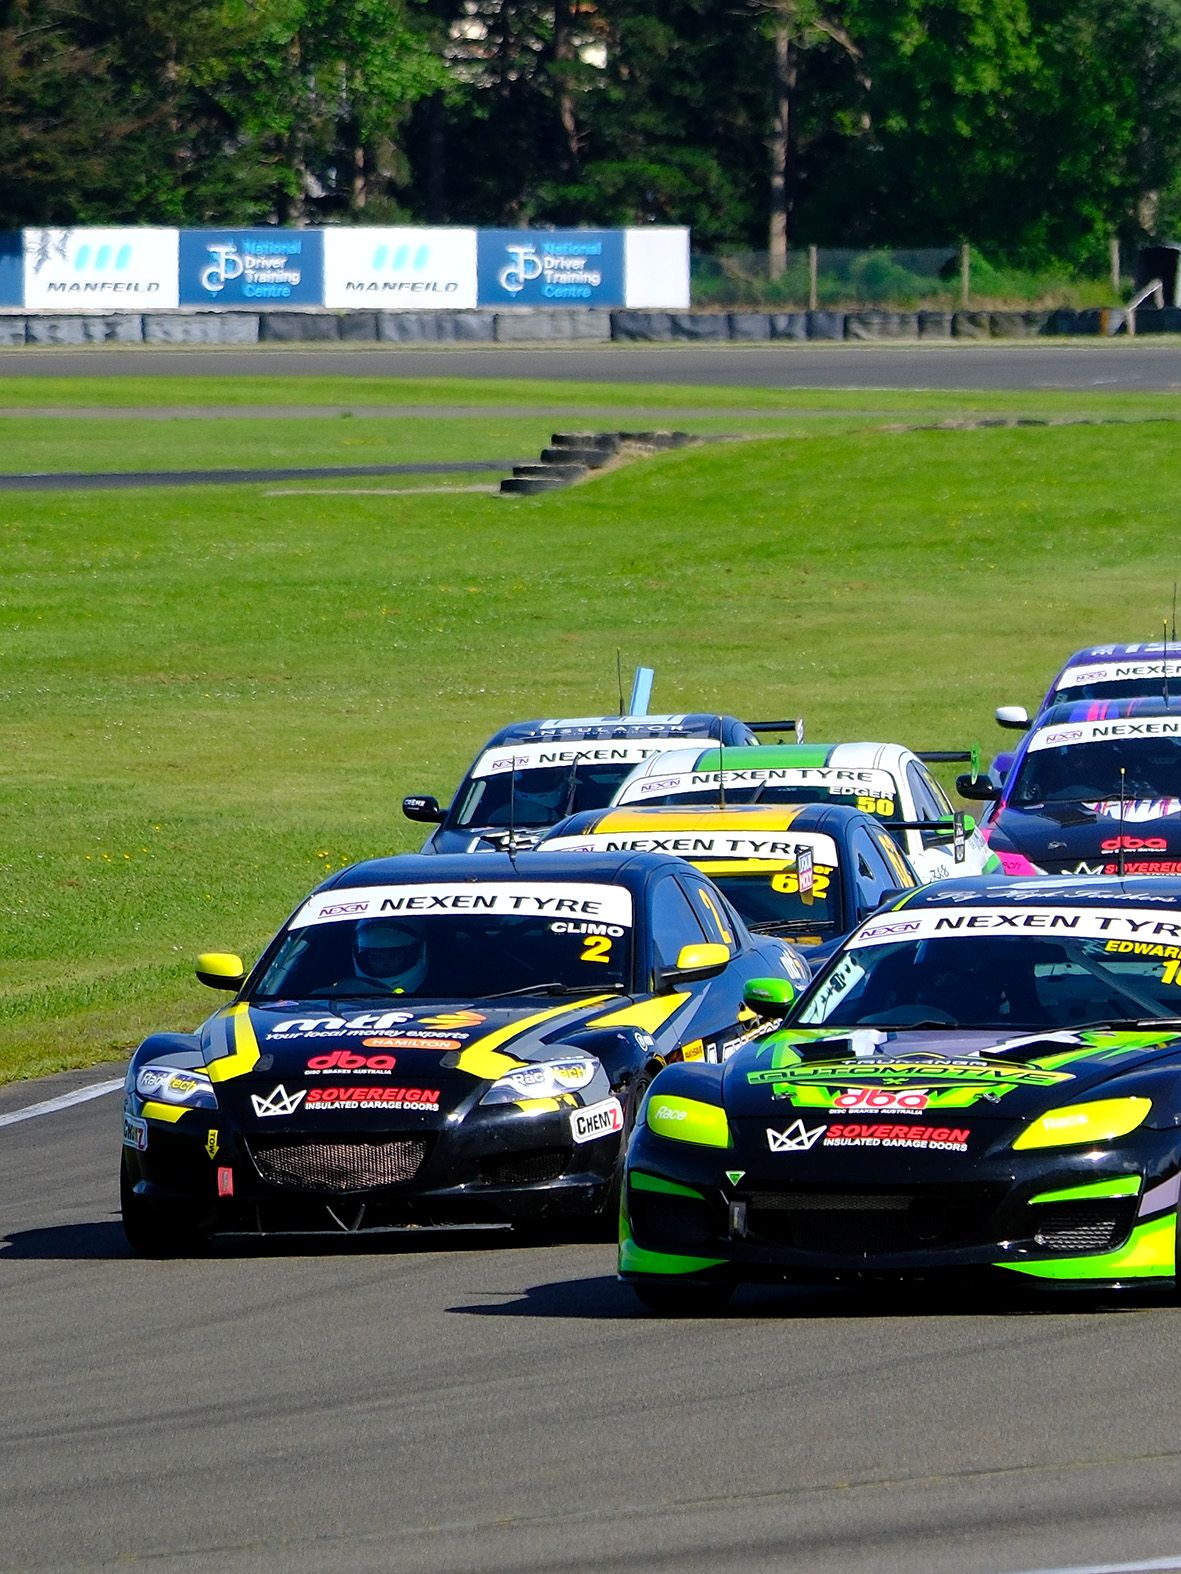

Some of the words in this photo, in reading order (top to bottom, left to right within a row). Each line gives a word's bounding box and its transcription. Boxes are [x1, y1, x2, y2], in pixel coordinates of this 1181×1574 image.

[244, 241, 300, 254] National
[544, 241, 600, 254] National
[245, 257, 287, 269] Driver
[545, 257, 586, 269] Driver
[245, 270, 300, 284] Training
[544, 270, 600, 284] Training
[47, 282, 159, 293] MANFEILD
[244, 286, 291, 298] Centre
[345, 282, 458, 292] MANFEILD
[544, 286, 591, 298] Centre
[1092, 723, 1179, 738] NEXEN
[540, 750, 628, 762] NEXEN
[692, 770, 789, 784] NEXEN
[799, 769, 873, 782] TYRE
[829, 786, 896, 800] EDGER
[856, 797, 894, 817] 50
[607, 839, 714, 851] NEXEN
[1101, 836, 1168, 852] dba
[771, 872, 830, 899] 62
[380, 896, 497, 912] NEXEN
[509, 896, 601, 914] TYRE
[550, 922, 624, 937] CLIMO
[935, 915, 1080, 930] NEXEN
[580, 936, 612, 964] 2
[273, 1012, 413, 1032] mtf
[304, 1030, 346, 1038] local
[347, 1030, 405, 1038] money
[406, 1031, 470, 1040] experts
[307, 1051, 396, 1069] dba
[759, 1067, 1059, 1082] AUTOMOTIVE
[307, 1088, 440, 1102] SOVEREIGN
[833, 1089, 929, 1109] dba
[305, 1102, 358, 1111] INSULATED
[360, 1101, 402, 1109] GARAGE
[403, 1102, 439, 1112] DOORS
[826, 1124, 971, 1142] SOVEREIGN
[823, 1139, 880, 1147] INSULATED
[882, 1139, 928, 1149] GARAGE
[929, 1141, 968, 1152] DOORS
